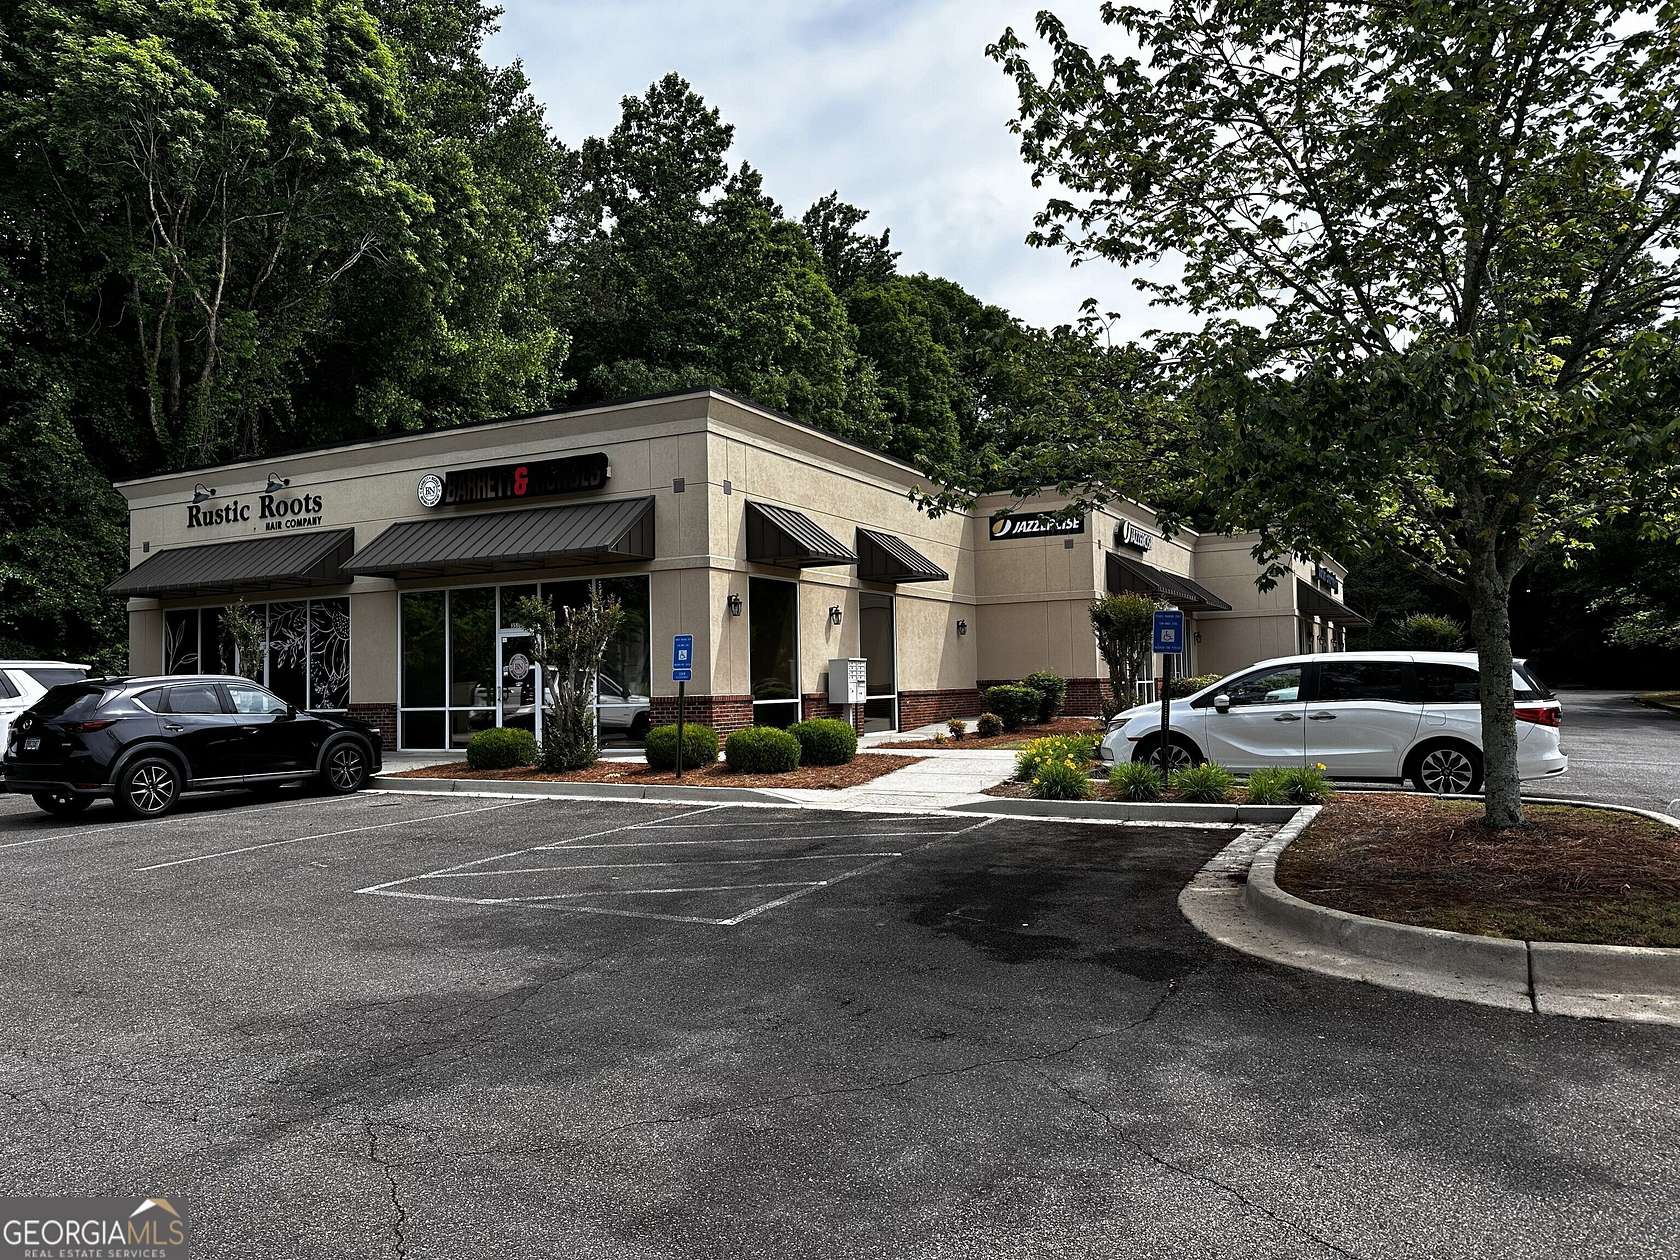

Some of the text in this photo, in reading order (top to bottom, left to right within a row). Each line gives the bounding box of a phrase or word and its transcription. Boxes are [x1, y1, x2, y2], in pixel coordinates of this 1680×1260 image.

[513, 465, 530, 497] &
[186, 493, 323, 528] Rustic Roots
[265, 516, 323, 531] HAIR COMPANY
